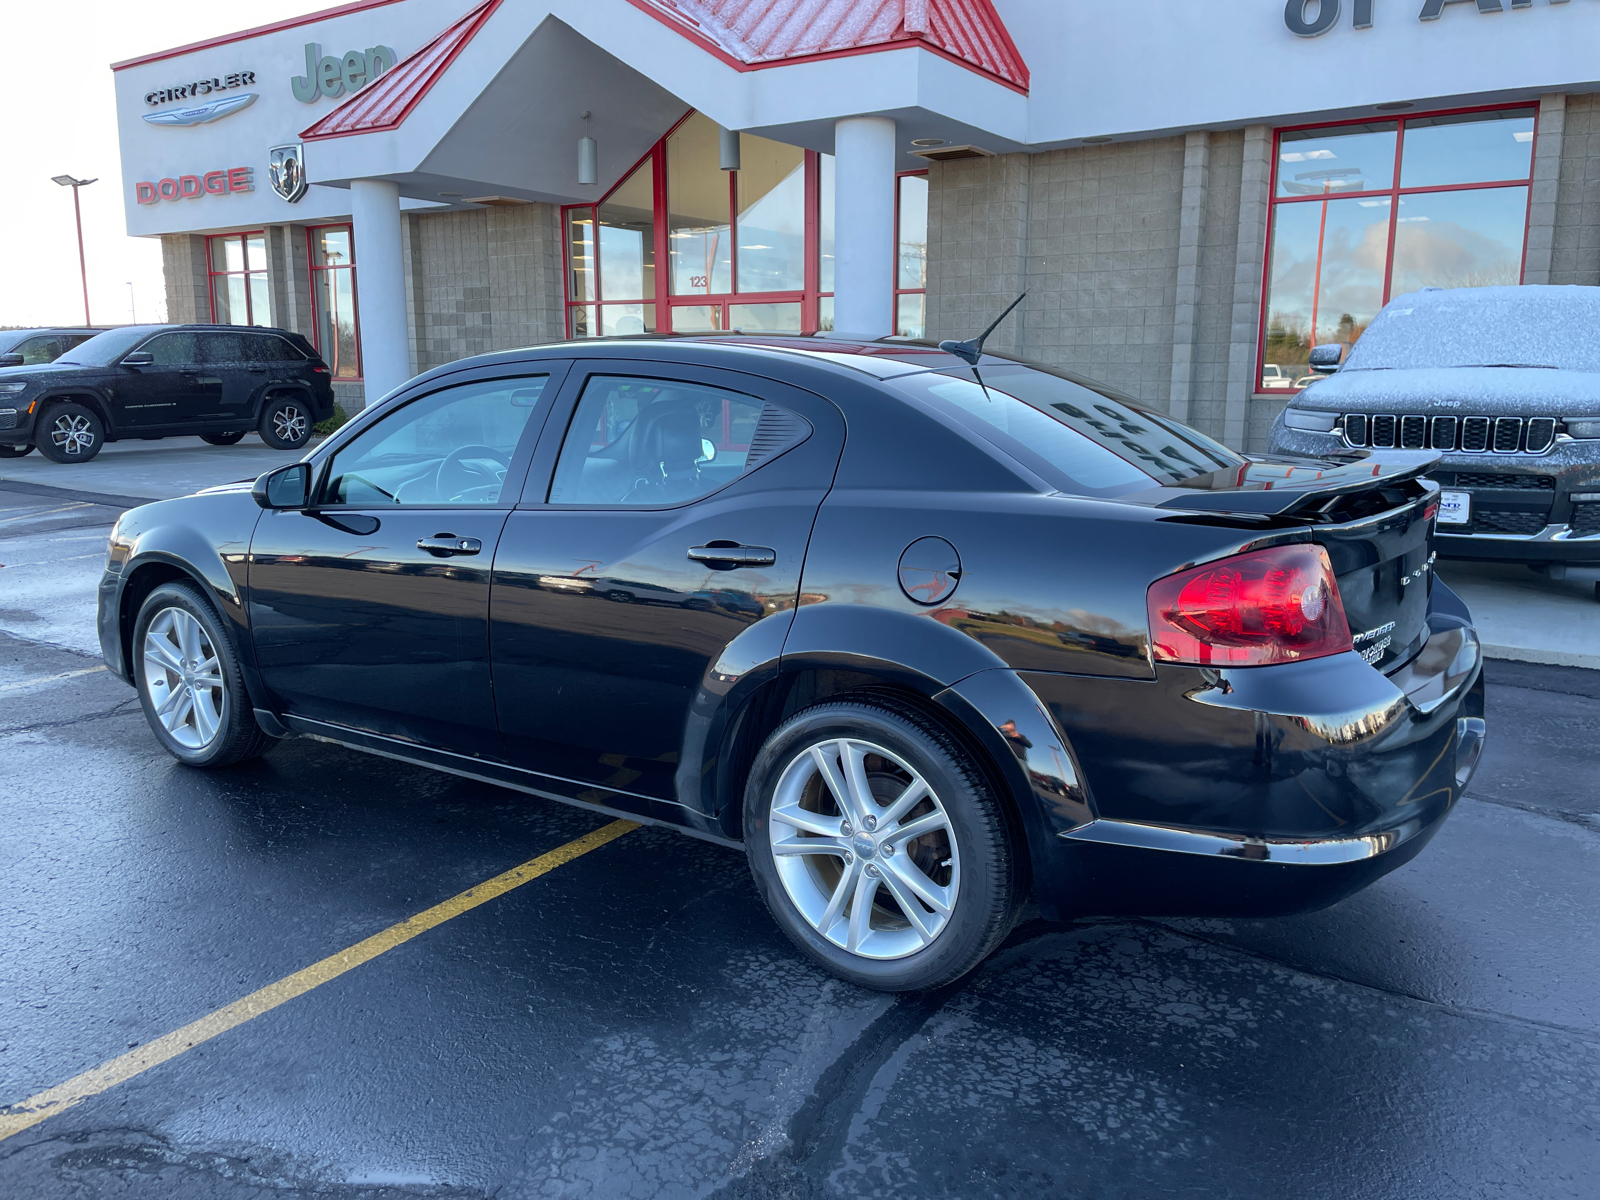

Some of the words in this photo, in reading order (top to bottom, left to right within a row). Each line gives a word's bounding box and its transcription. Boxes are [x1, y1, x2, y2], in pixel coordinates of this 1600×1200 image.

[144, 70, 256, 105] CHRYSLER
[136, 166, 255, 205] DODGE
[689, 276, 707, 287] 123
[1433, 399, 1460, 408] Jeep
